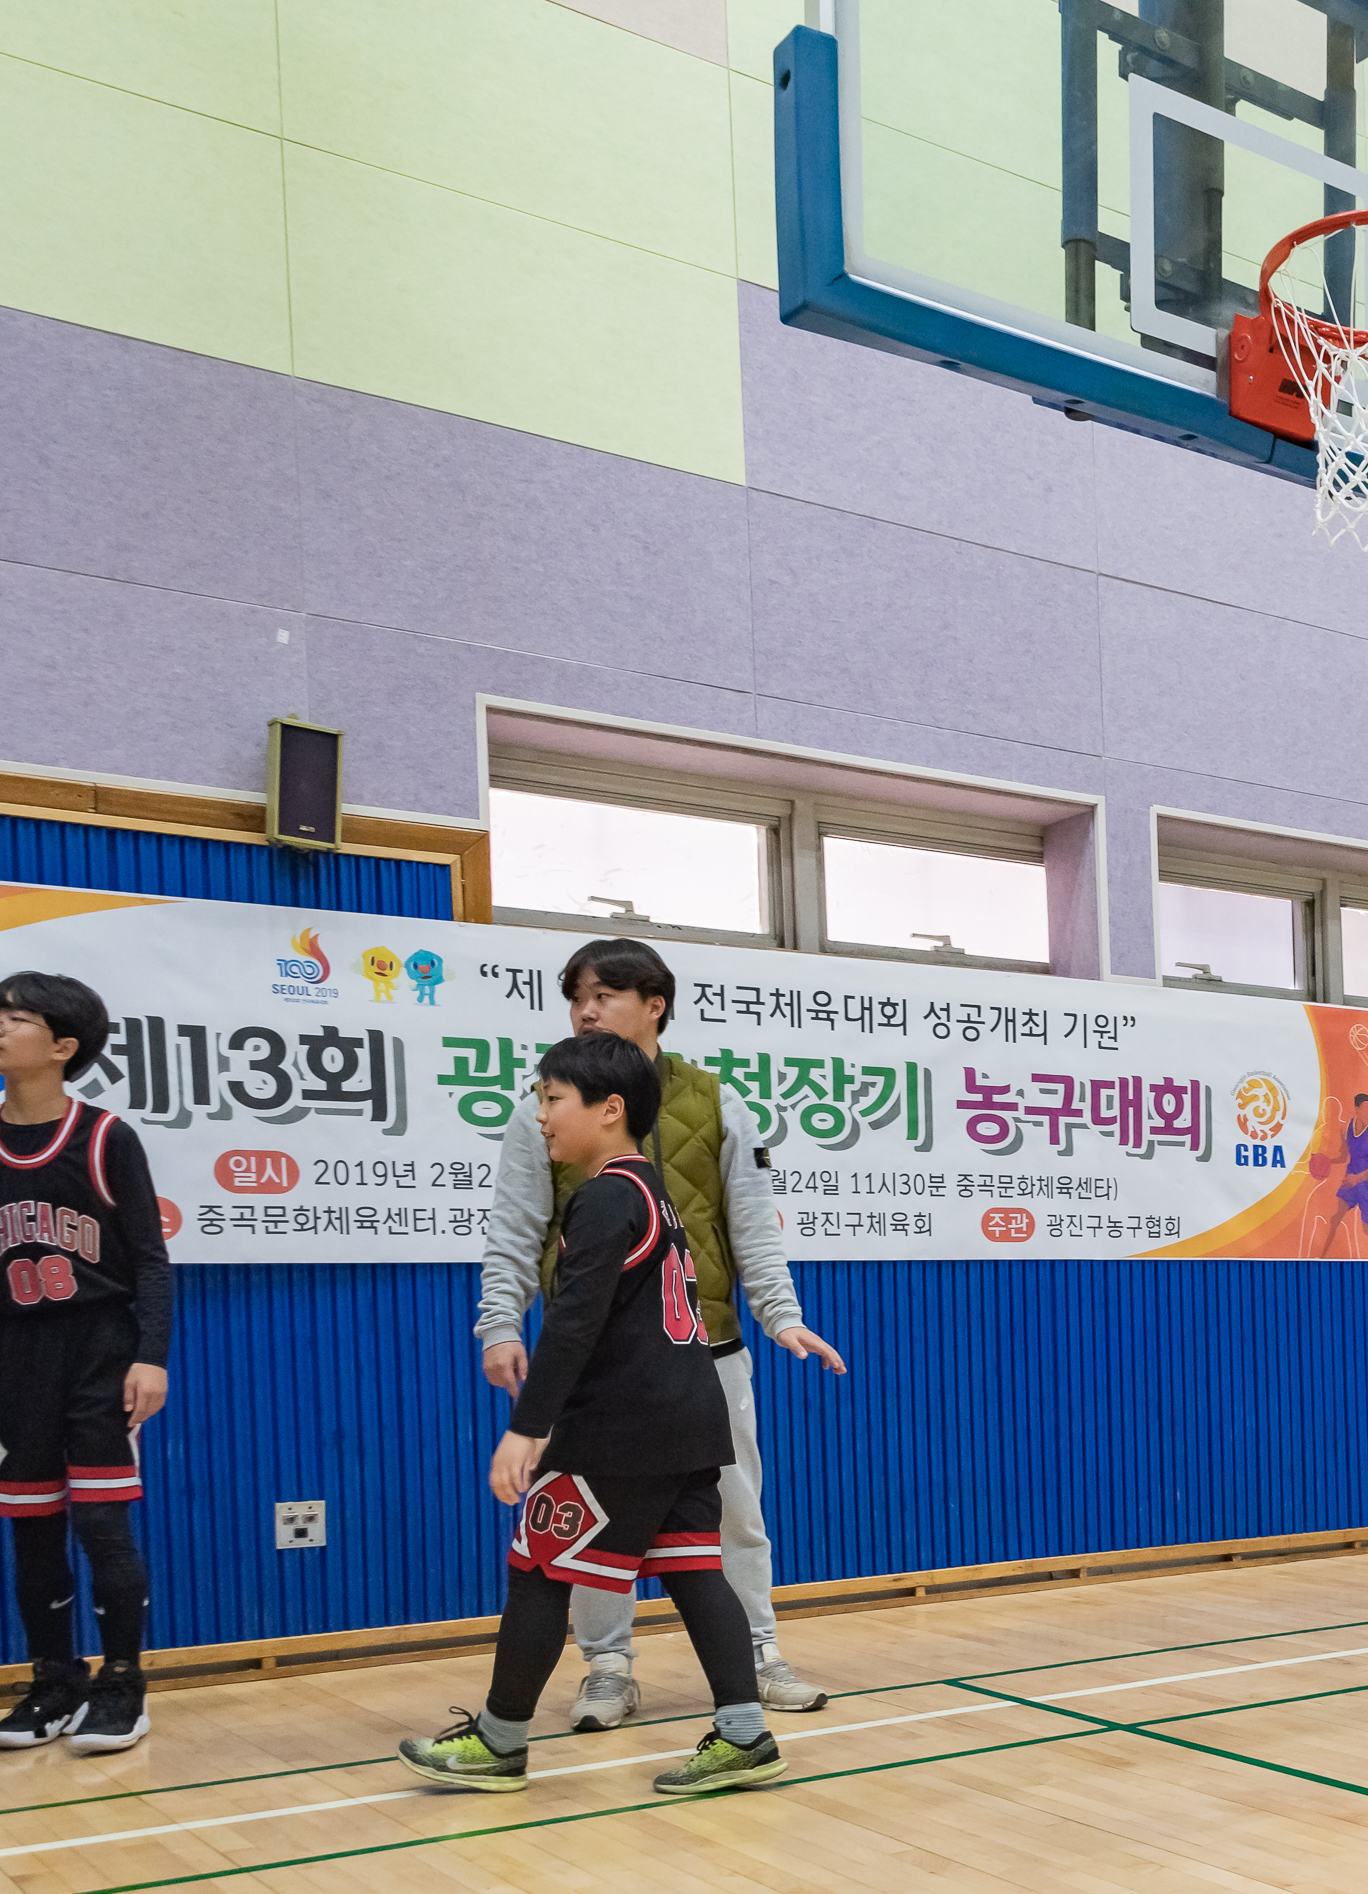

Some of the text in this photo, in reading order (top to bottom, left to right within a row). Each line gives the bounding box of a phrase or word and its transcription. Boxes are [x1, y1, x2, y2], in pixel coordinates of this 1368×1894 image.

[271, 983, 339, 999] SEOUL 2019
[692, 981, 909, 1037] 전국체육대회
[922, 1000, 1049, 1046] 성공개최
[1062, 1010, 1137, 1051] 기원”
[68, 1015, 1203, 1152] 제13회 광청장기 농구대회
[228, 1155, 289, 1188] 일시
[313, 1159, 417, 1189] 2019년
[850, 1172, 948, 1198] 11시30분
[955, 1173, 1119, 1202] 중곡문화체육센타)
[1235, 1143, 1287, 1169] GBA
[0, 1200, 100, 1264] HICAGO
[796, 1210, 934, 1238] 광진구체육회
[987, 1213, 1030, 1238] 주관
[1046, 1214, 1182, 1239] 광진구농구협회
[7, 1254, 78, 1306] 08
[528, 1491, 585, 1541] 03
